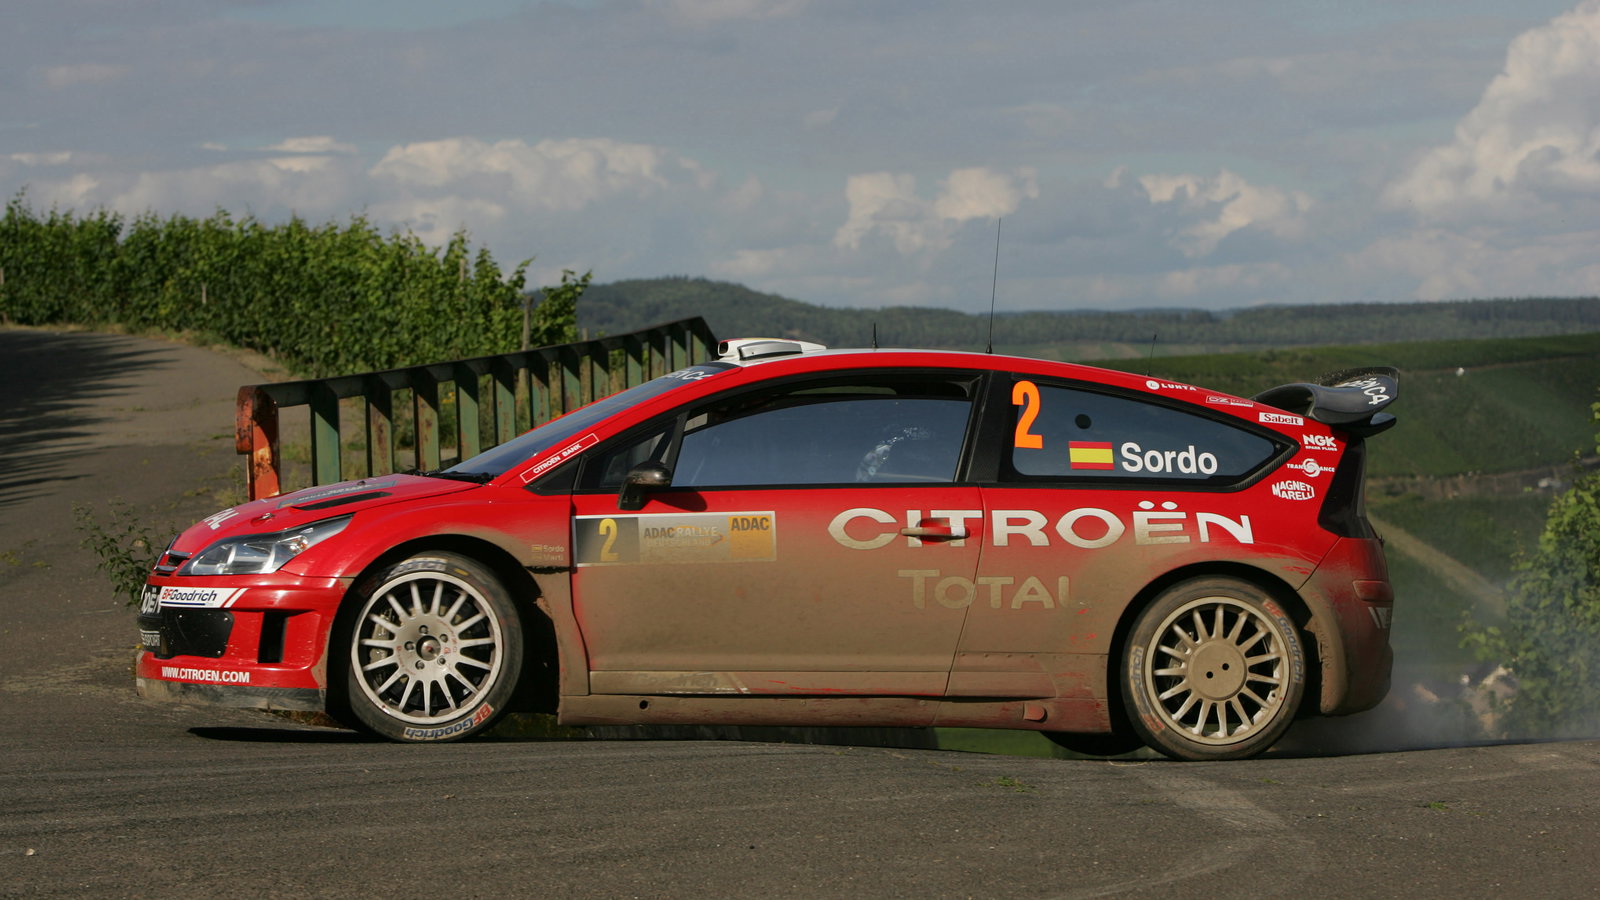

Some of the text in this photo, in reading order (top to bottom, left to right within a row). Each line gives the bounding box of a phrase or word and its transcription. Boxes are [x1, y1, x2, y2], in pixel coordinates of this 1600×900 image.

[1161, 383, 1197, 391] LUHTA
[1012, 380, 1043, 449] 2
[1263, 413, 1300, 426] Sabelt
[1302, 434, 1337, 448] NGK
[533, 444, 582, 474] CITROËN BANK
[1120, 442, 1218, 475] Sordo
[1272, 480, 1315, 493] MAGNETI
[643, 526, 719, 539] ADAC RALLYE
[731, 517, 770, 531] ADAC
[827, 500, 1254, 550] CITROËN
[599, 518, 620, 562] 2
[161, 588, 218, 602] BFGoodrich
[897, 568, 1084, 610] TOTAL
[162, 666, 250, 683] WWW.CITROEN.COM
[405, 703, 493, 739] BFGoodrich
